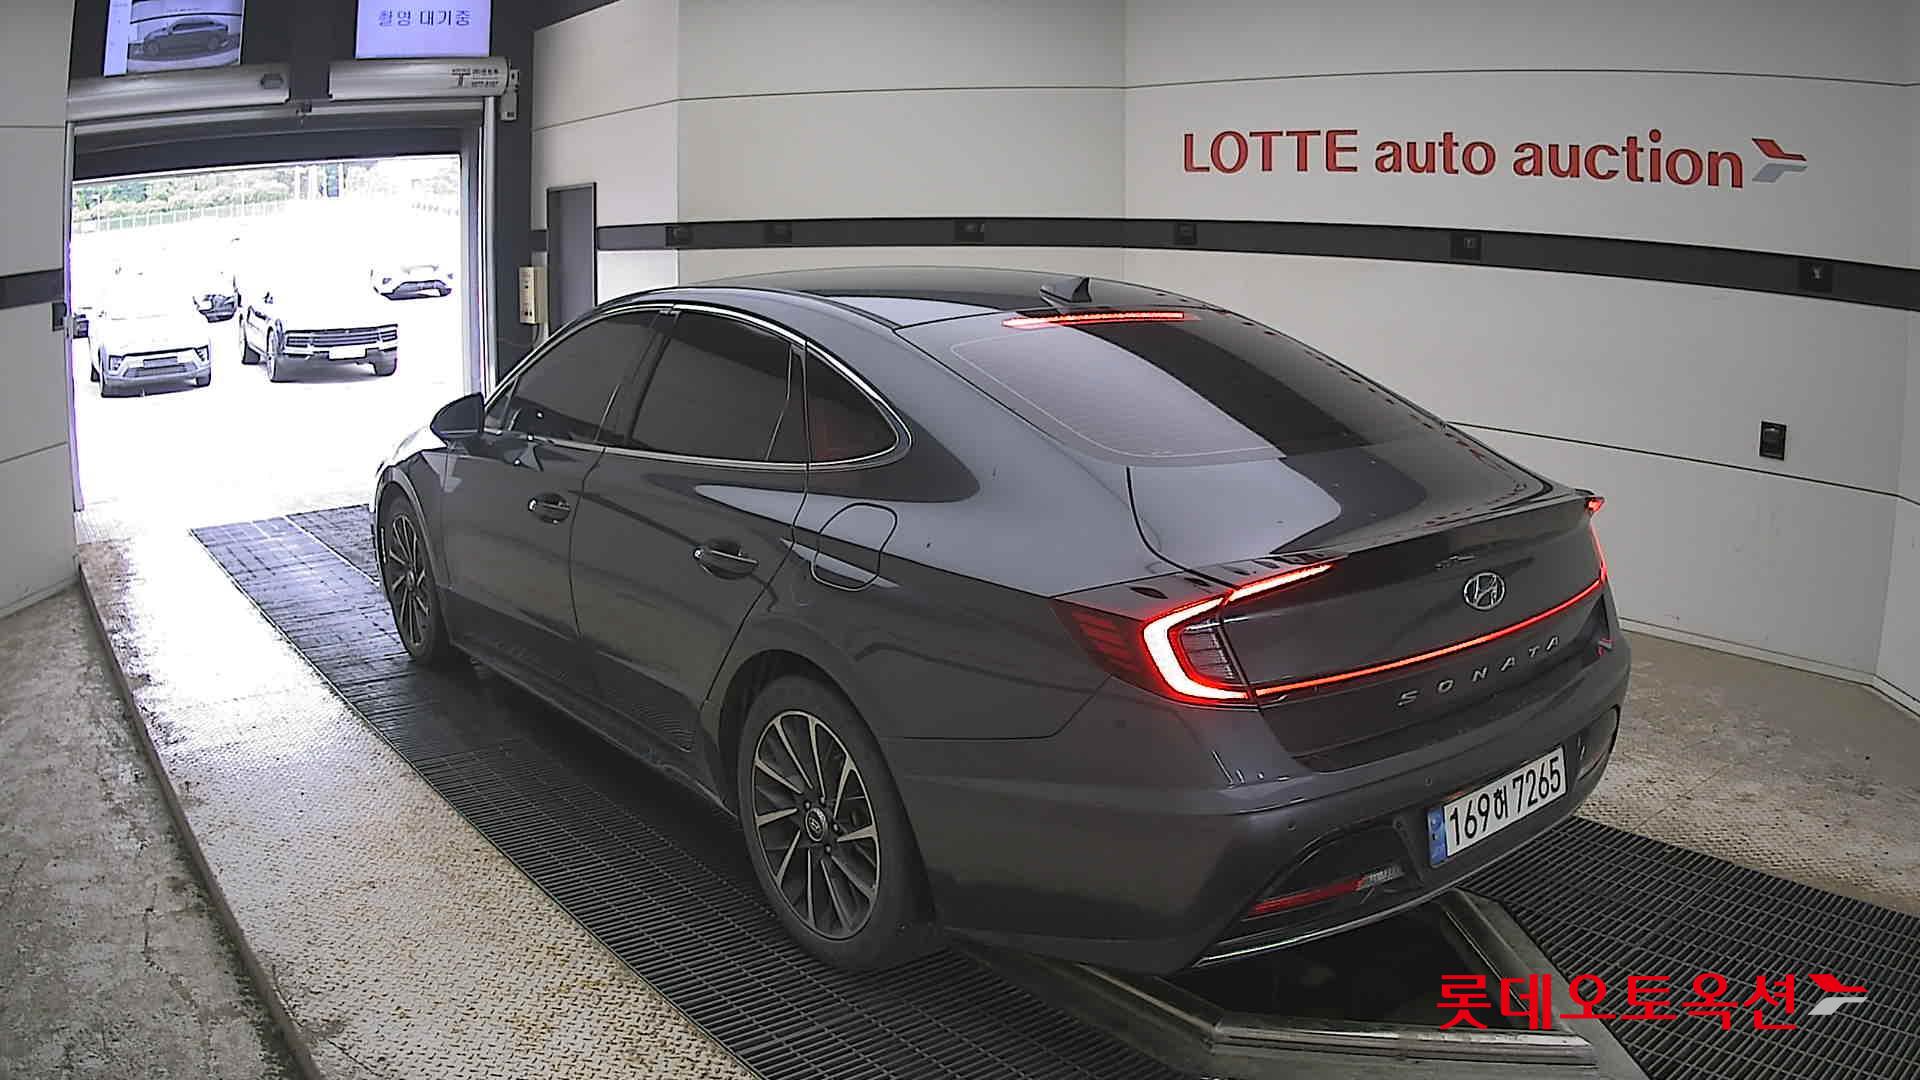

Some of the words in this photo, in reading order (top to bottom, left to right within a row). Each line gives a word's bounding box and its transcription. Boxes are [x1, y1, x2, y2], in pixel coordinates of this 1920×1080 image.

[419, 9, 471, 26] 대기중
[1183, 129, 1358, 174] LOTTE
[1375, 131, 1497, 176] auto
[1512, 128, 1745, 189] auction
[1397, 635, 1561, 706] SONATA
[1449, 784, 1509, 846] 169허
[1512, 756, 1562, 814] 7265
